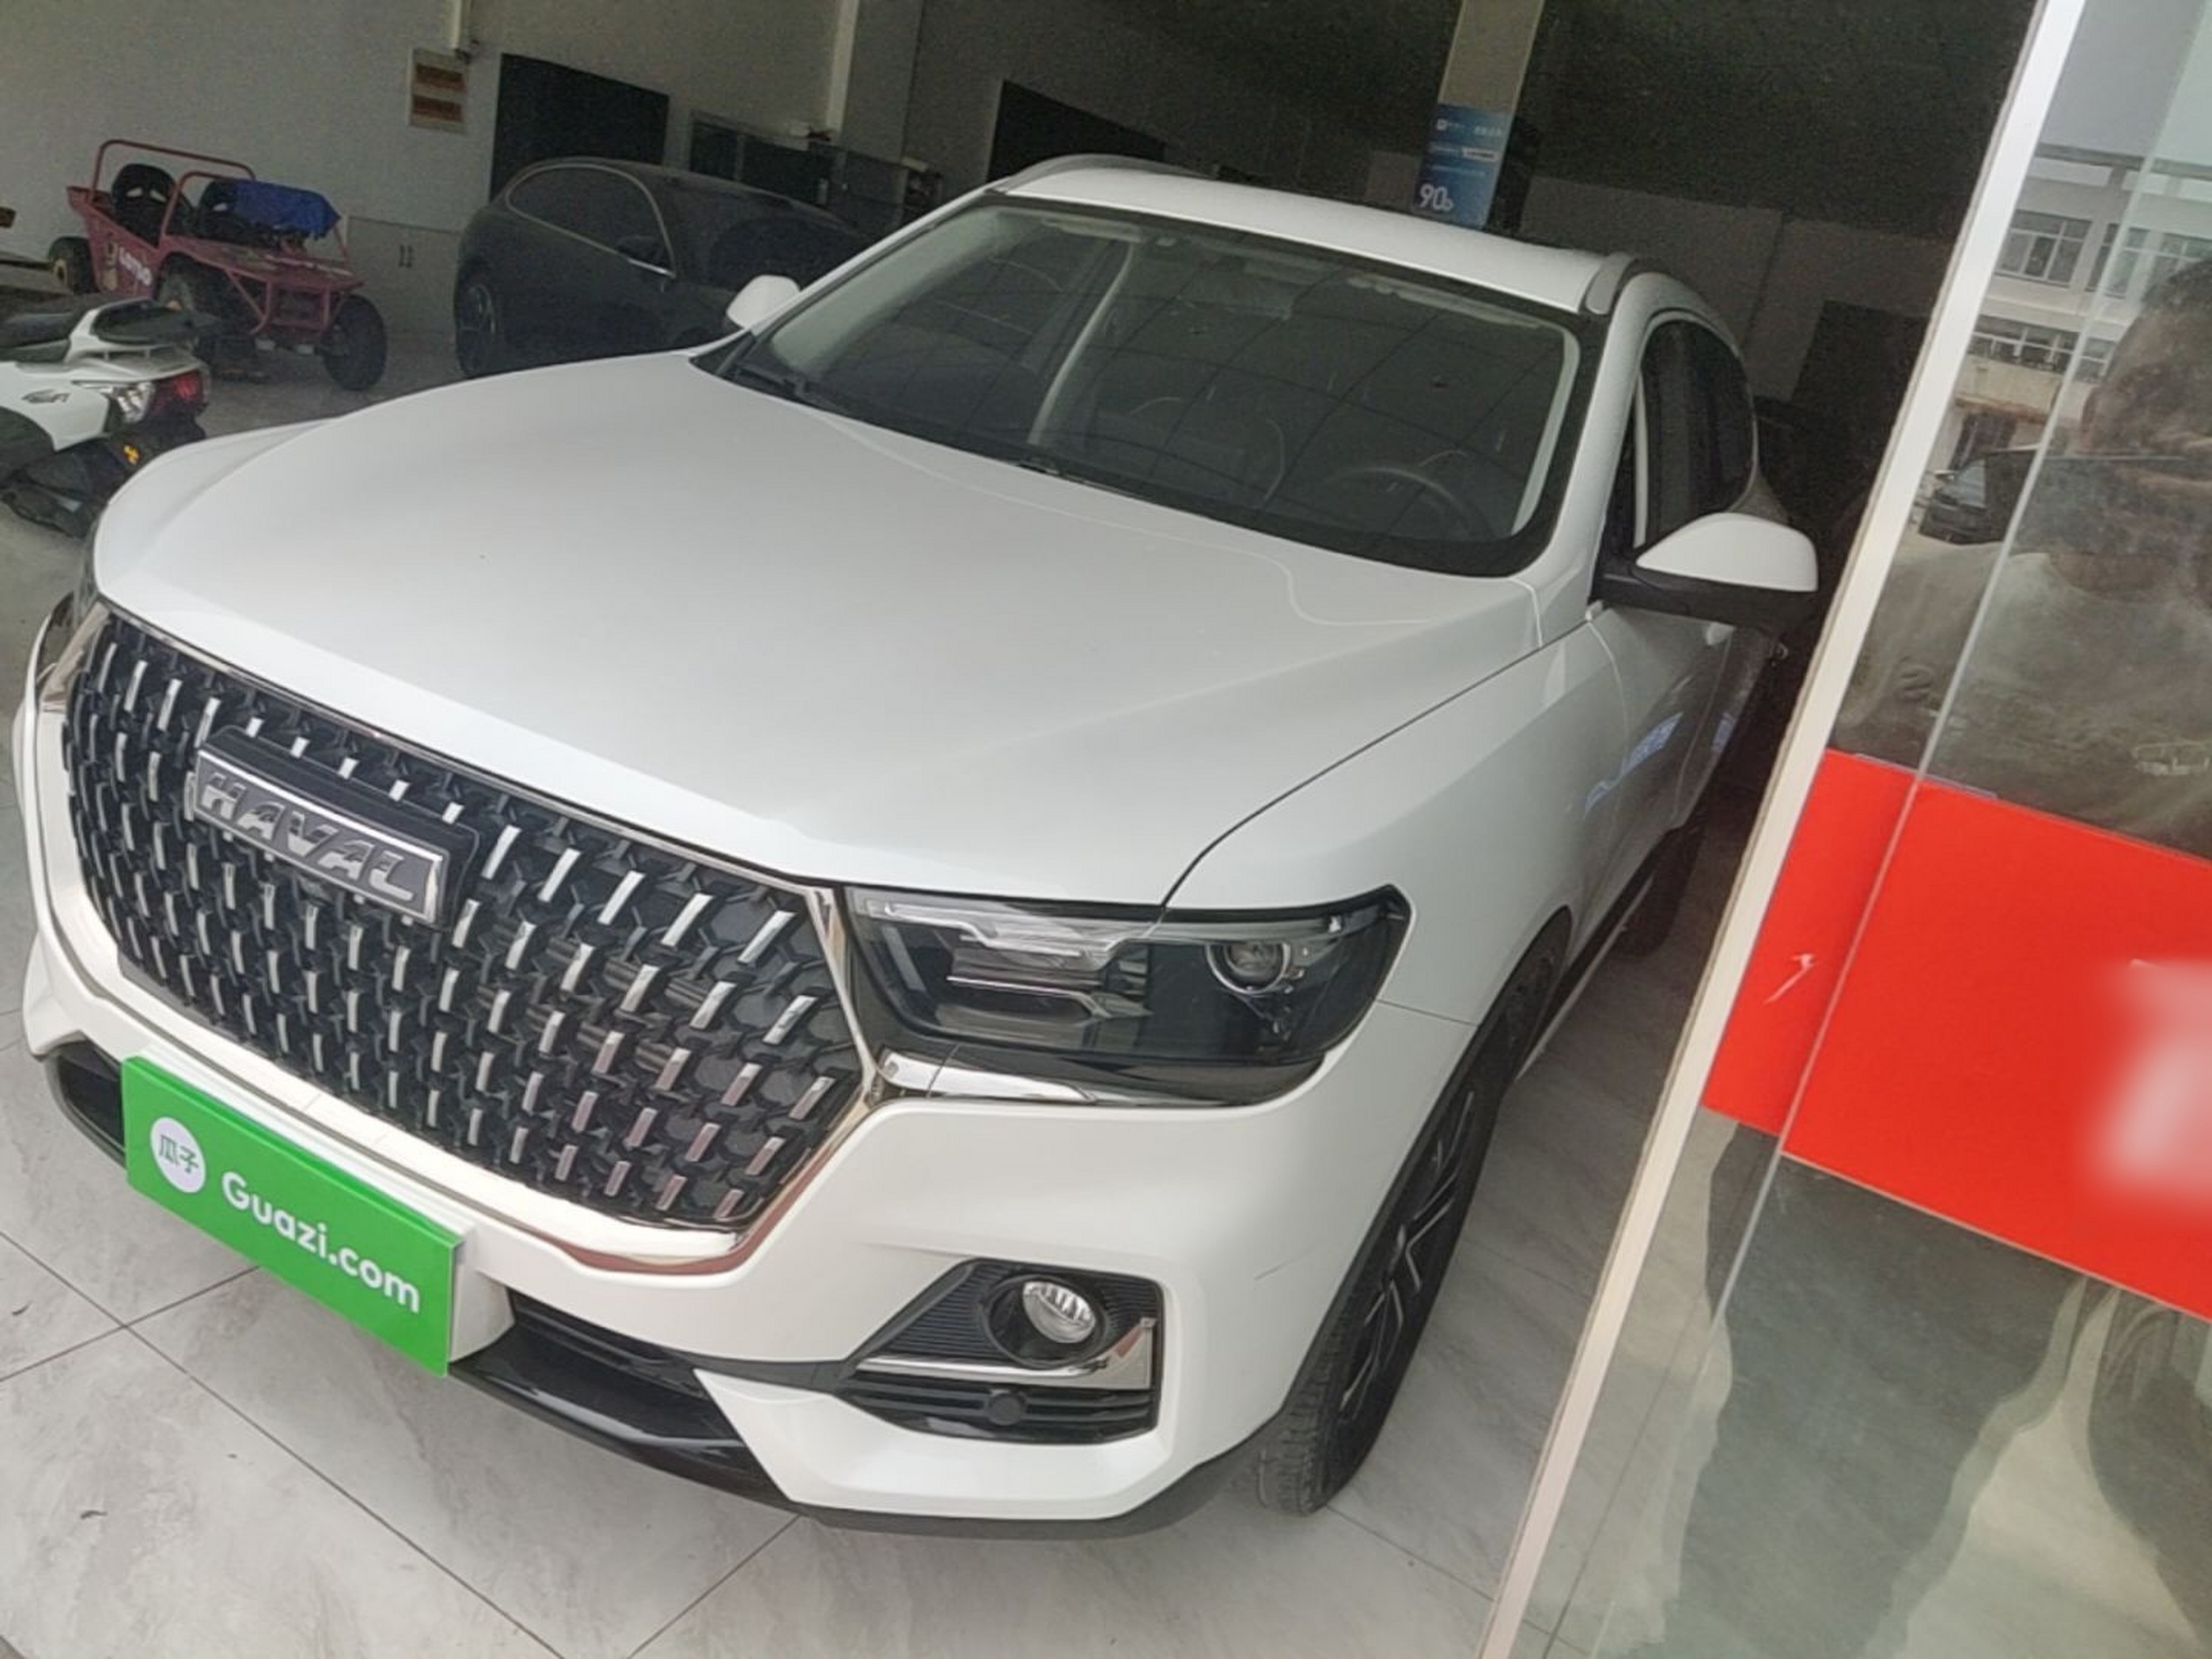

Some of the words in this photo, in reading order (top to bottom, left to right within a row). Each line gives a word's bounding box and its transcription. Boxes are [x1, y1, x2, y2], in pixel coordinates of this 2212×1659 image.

[200, 771, 414, 902] HAVAL
[158, 1133, 199, 1174] 瓜子
[221, 1171, 420, 1315] Guazi.com
